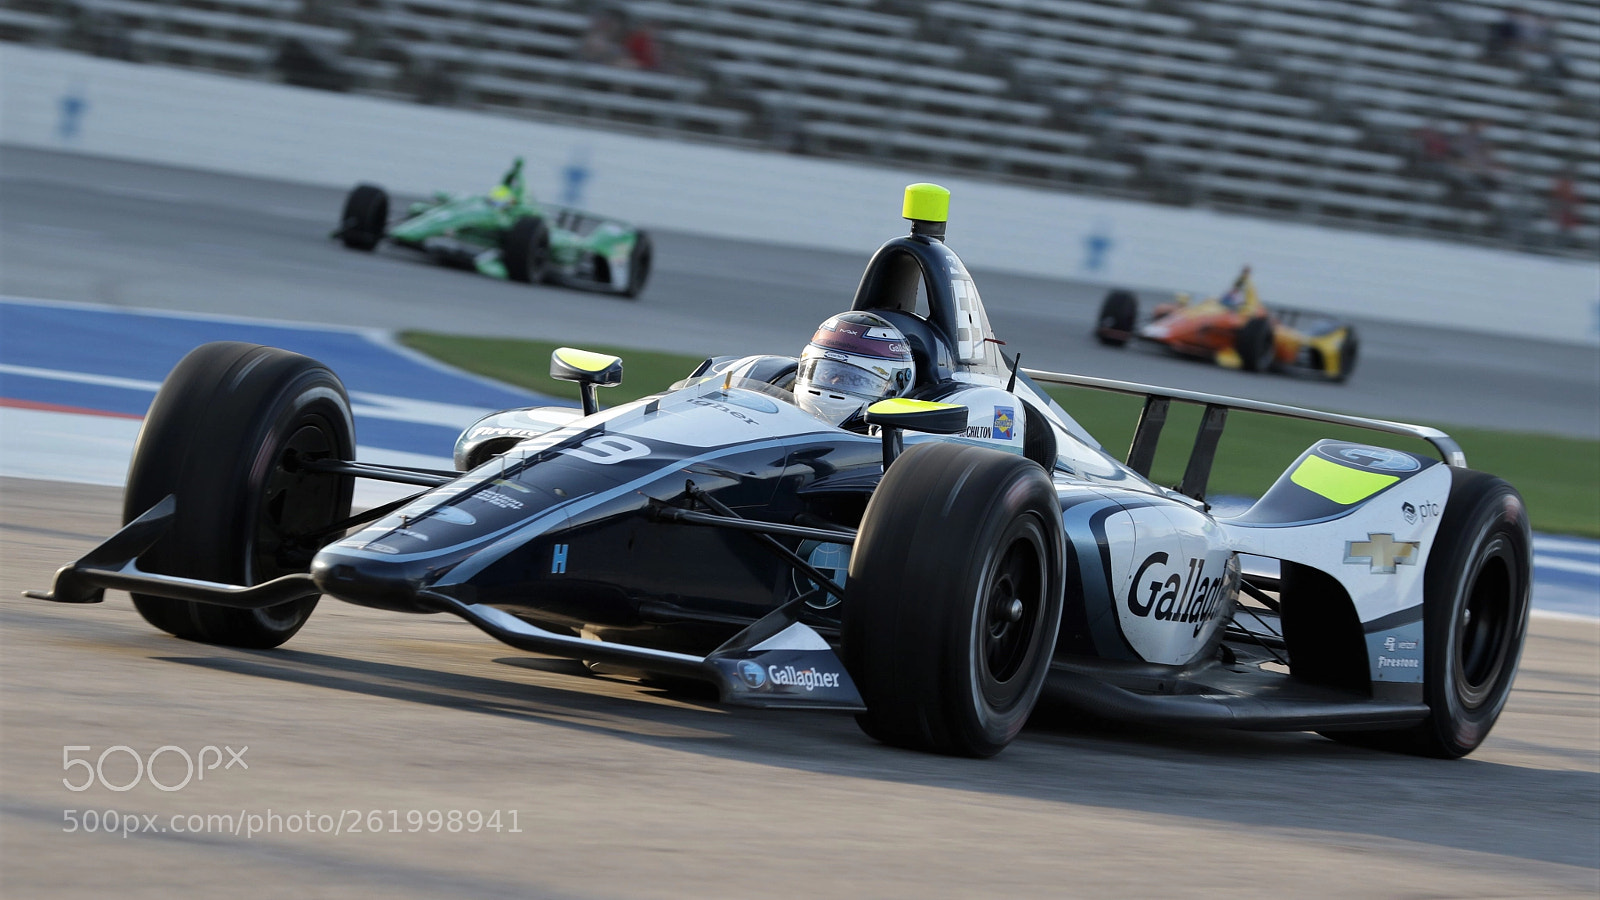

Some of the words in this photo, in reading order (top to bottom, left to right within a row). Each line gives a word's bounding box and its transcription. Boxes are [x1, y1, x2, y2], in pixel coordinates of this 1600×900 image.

[966, 426, 992, 438] CHILTON
[1419, 500, 1440, 523] ptc
[551, 543, 569, 574] H
[1127, 551, 1229, 639] Gallag
[1378, 656, 1419, 669] Firestone
[768, 664, 840, 692] Gallagher
